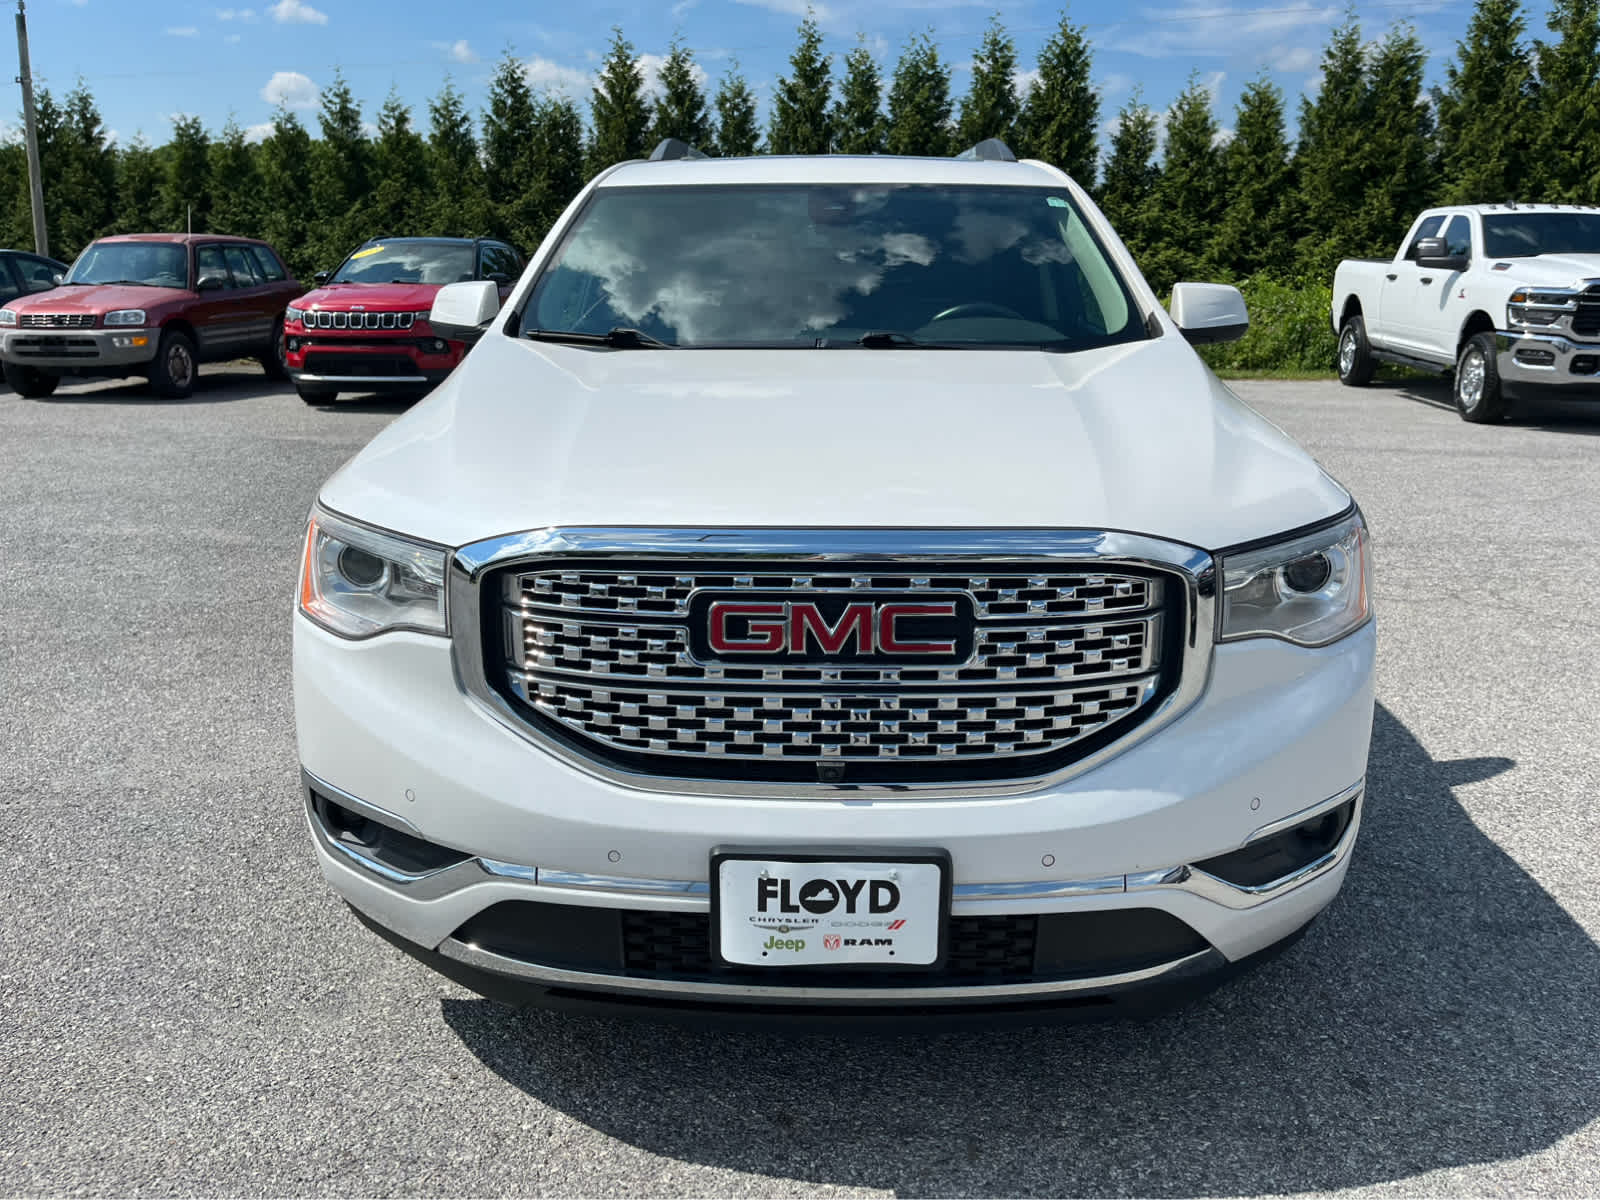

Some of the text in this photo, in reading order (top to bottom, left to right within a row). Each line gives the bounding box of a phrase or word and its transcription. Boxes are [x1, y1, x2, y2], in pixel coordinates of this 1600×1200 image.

[708, 600, 956, 655] GMC
[757, 878, 900, 914] FLOYD
[764, 936, 806, 951] Jeep
[844, 938, 893, 947] RAM
